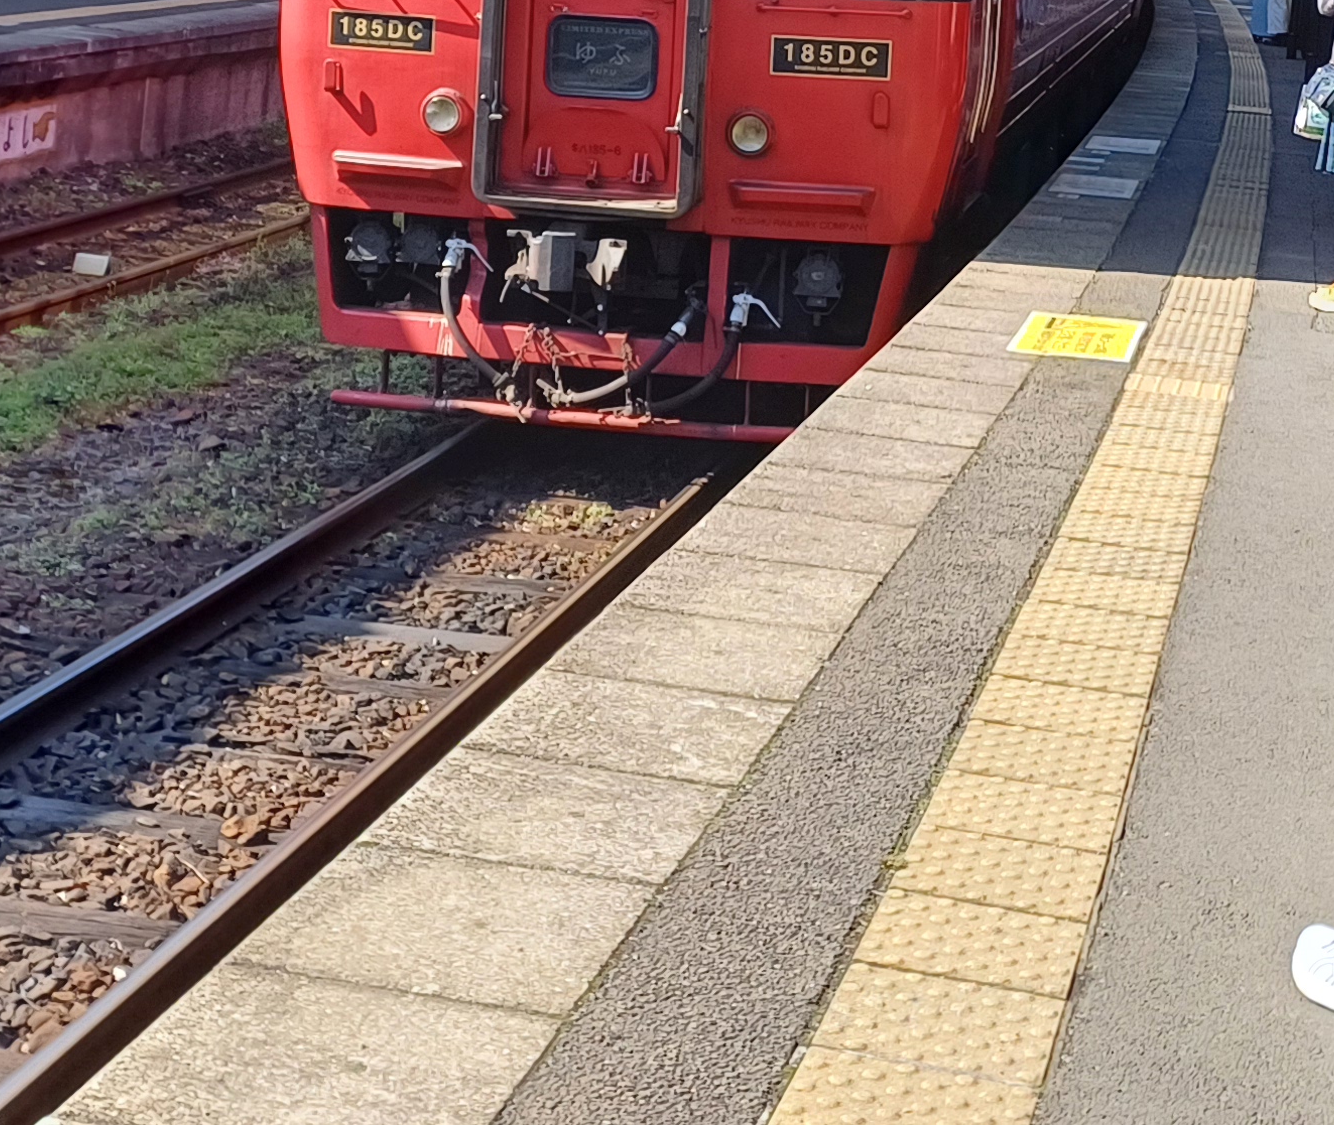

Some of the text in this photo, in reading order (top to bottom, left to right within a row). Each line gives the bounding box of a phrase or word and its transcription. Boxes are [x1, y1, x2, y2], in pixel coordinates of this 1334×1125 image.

[339, 15, 424, 41] 185DC
[575, 41, 631, 66] ゆふ
[783, 42, 879, 67] 185DC
